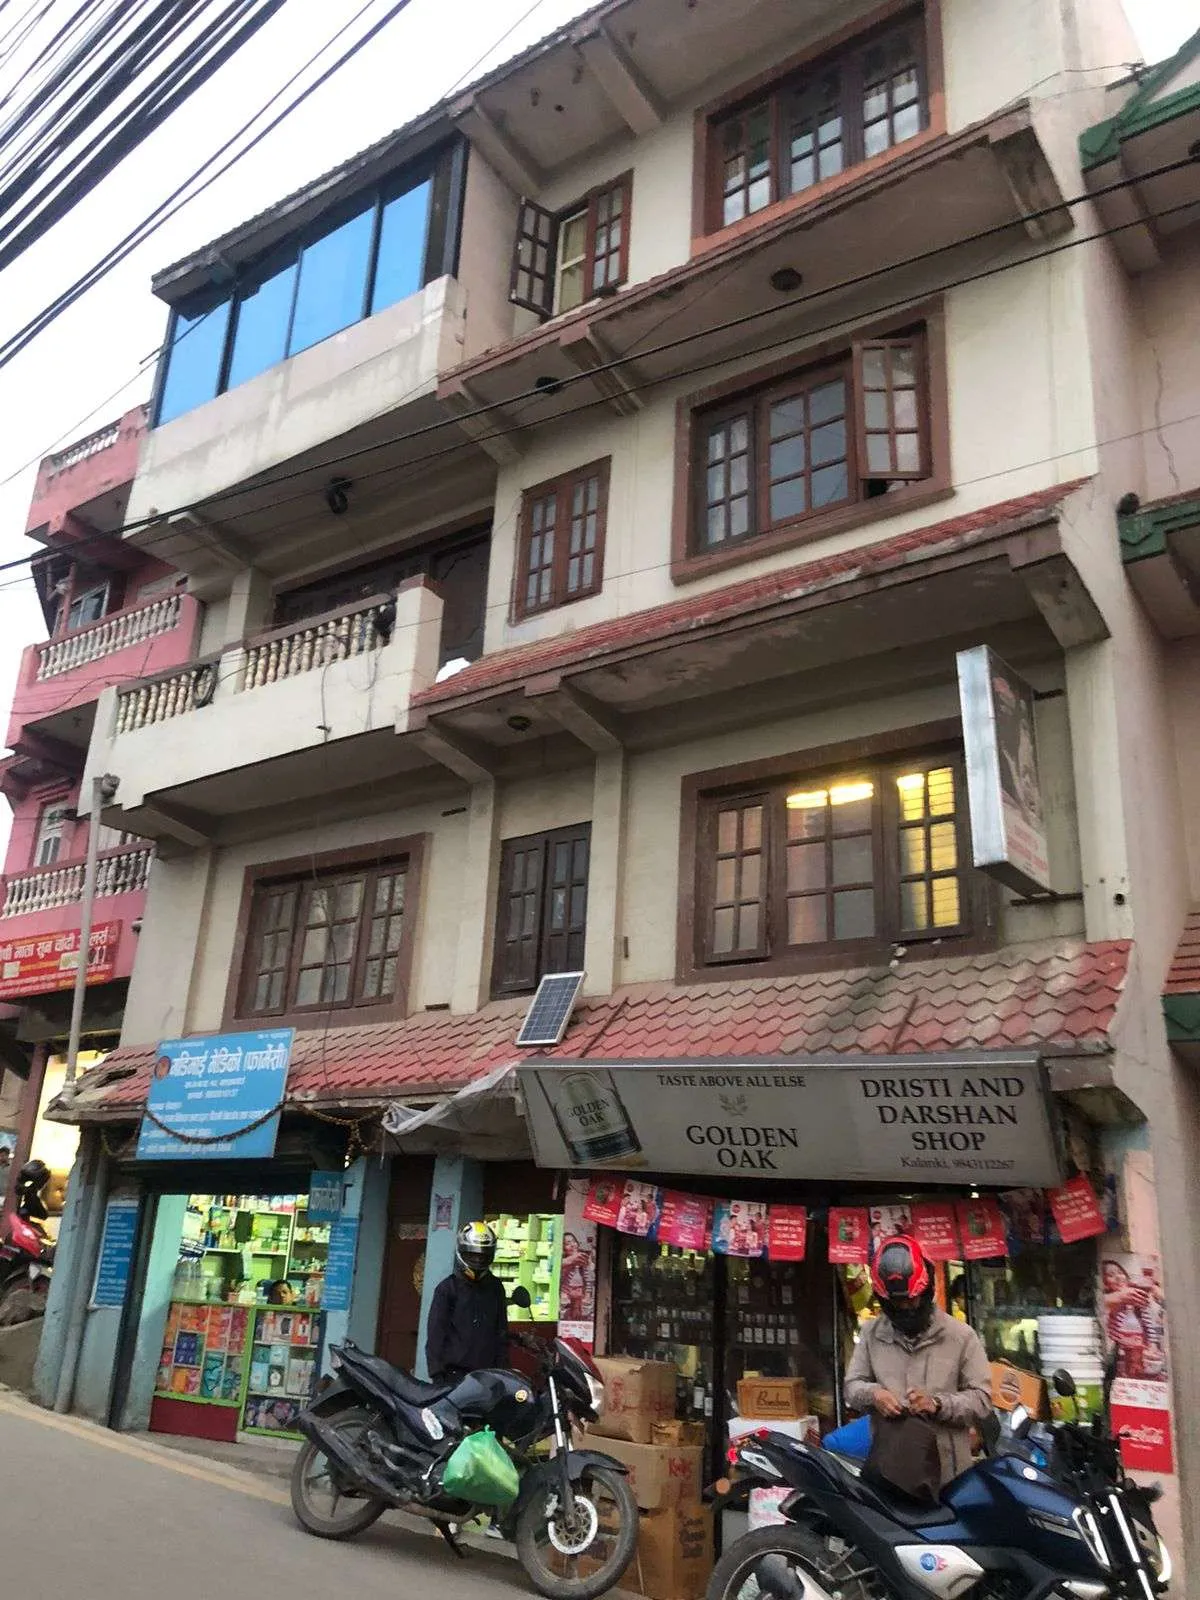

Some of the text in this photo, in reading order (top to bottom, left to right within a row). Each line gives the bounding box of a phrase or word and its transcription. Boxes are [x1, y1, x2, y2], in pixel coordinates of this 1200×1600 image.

[657, 1075, 806, 1087] TASTE ABOVE ALL ELSE
[860, 1077, 1024, 1098] DRISTI AND
[876, 1105, 1018, 1124] DARSHAN
[686, 1125, 798, 1148] GOLDEN
[911, 1131, 986, 1151] SHOP
[717, 1148, 778, 1169] OAK
